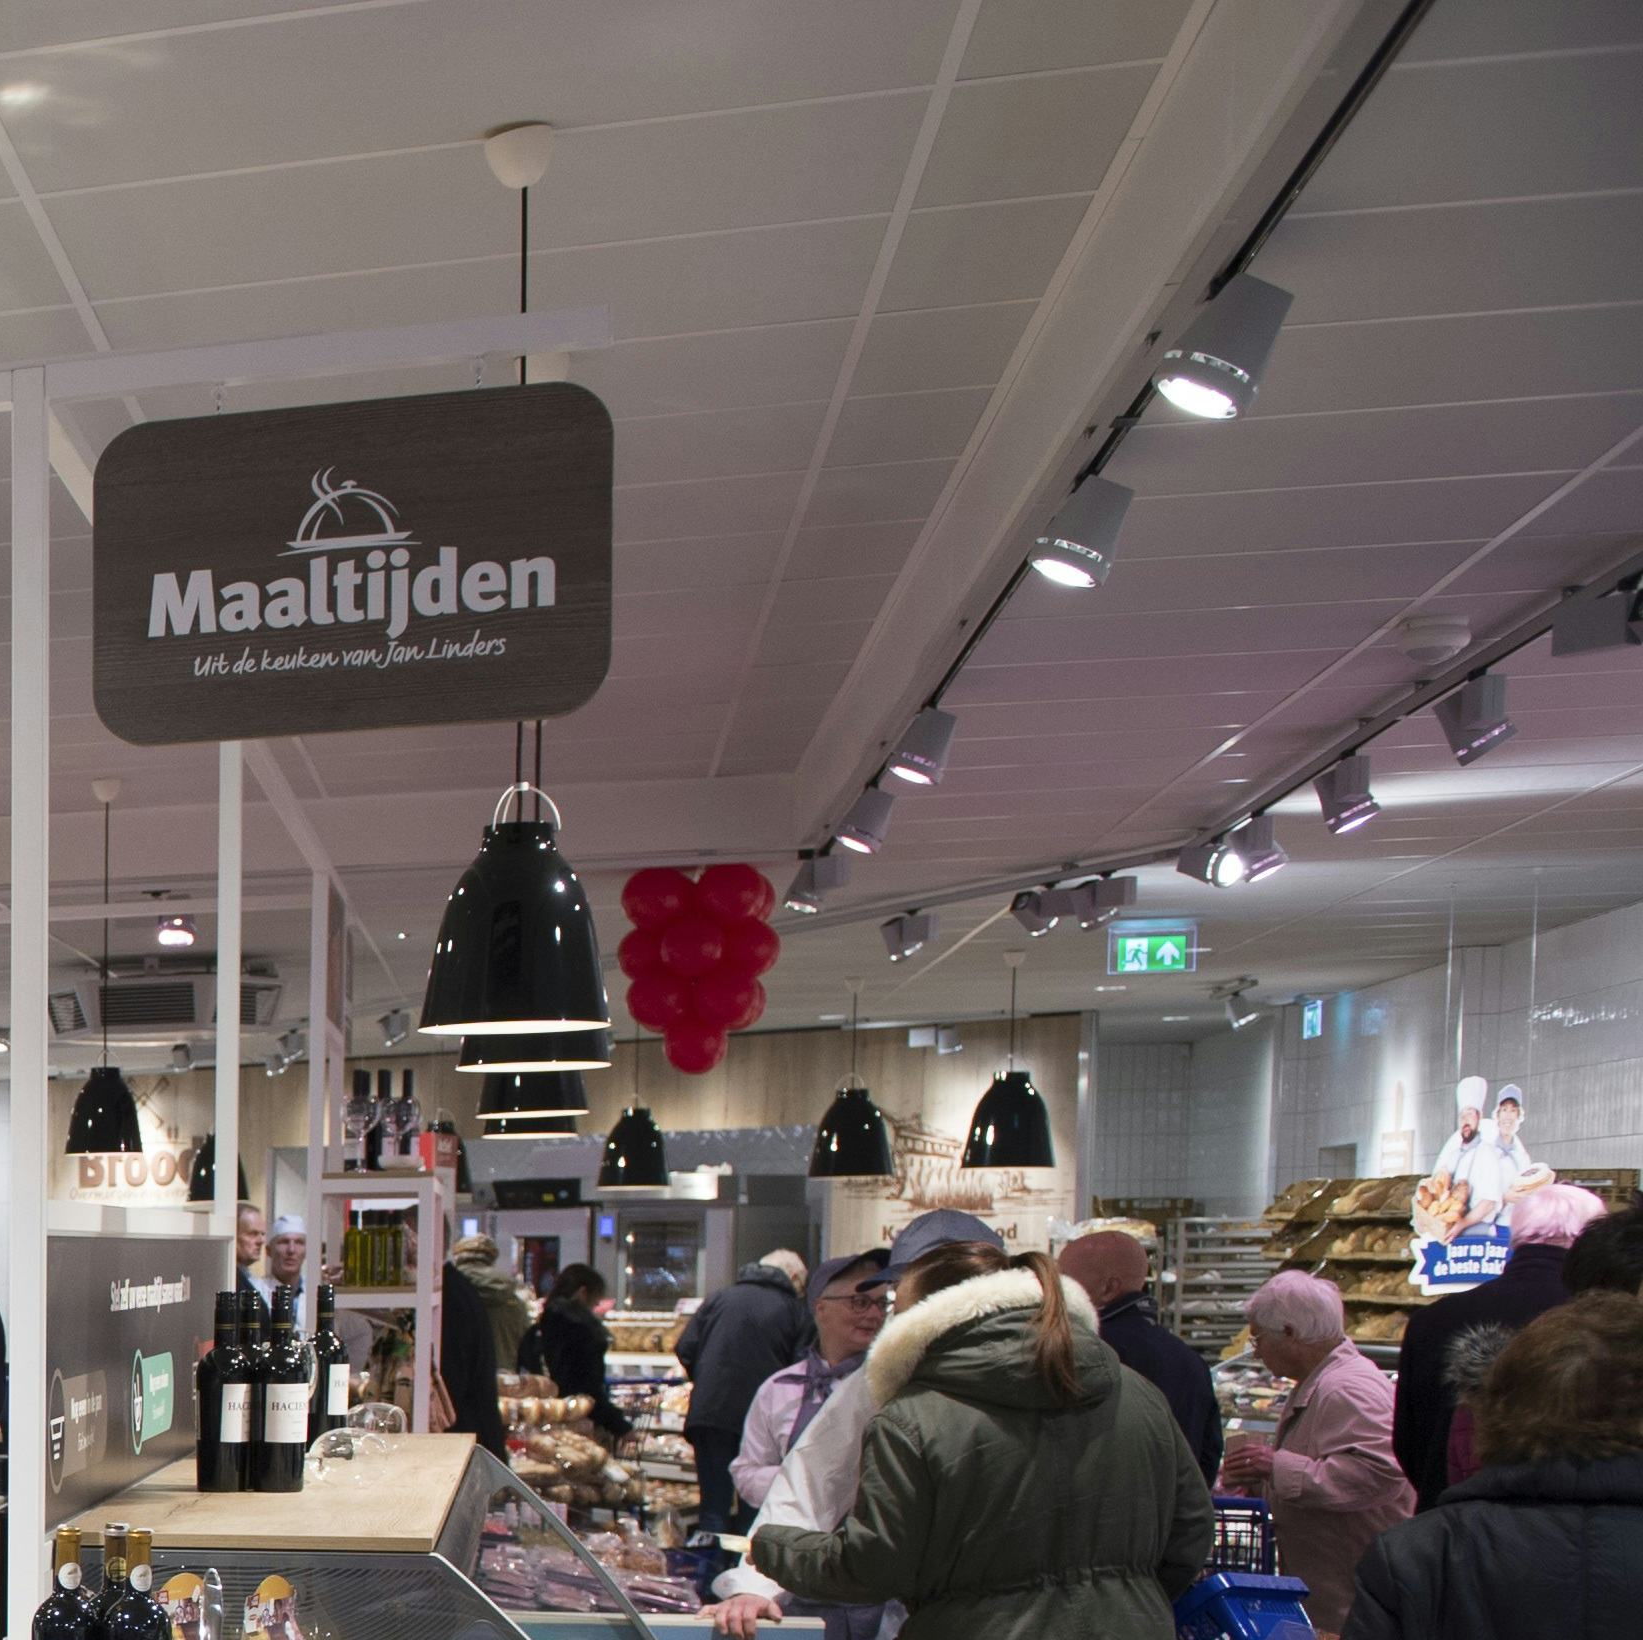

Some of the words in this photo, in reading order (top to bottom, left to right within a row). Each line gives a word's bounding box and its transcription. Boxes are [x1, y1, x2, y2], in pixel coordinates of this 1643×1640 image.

[148, 545, 556, 639] Maaltijden
[194, 655, 230, 677] Uit
[232, 645, 257, 674] de
[261, 641, 339, 672] keuken
[341, 648, 379, 668] van
[380, 640, 426, 669] Jan
[428, 630, 507, 661] Linders
